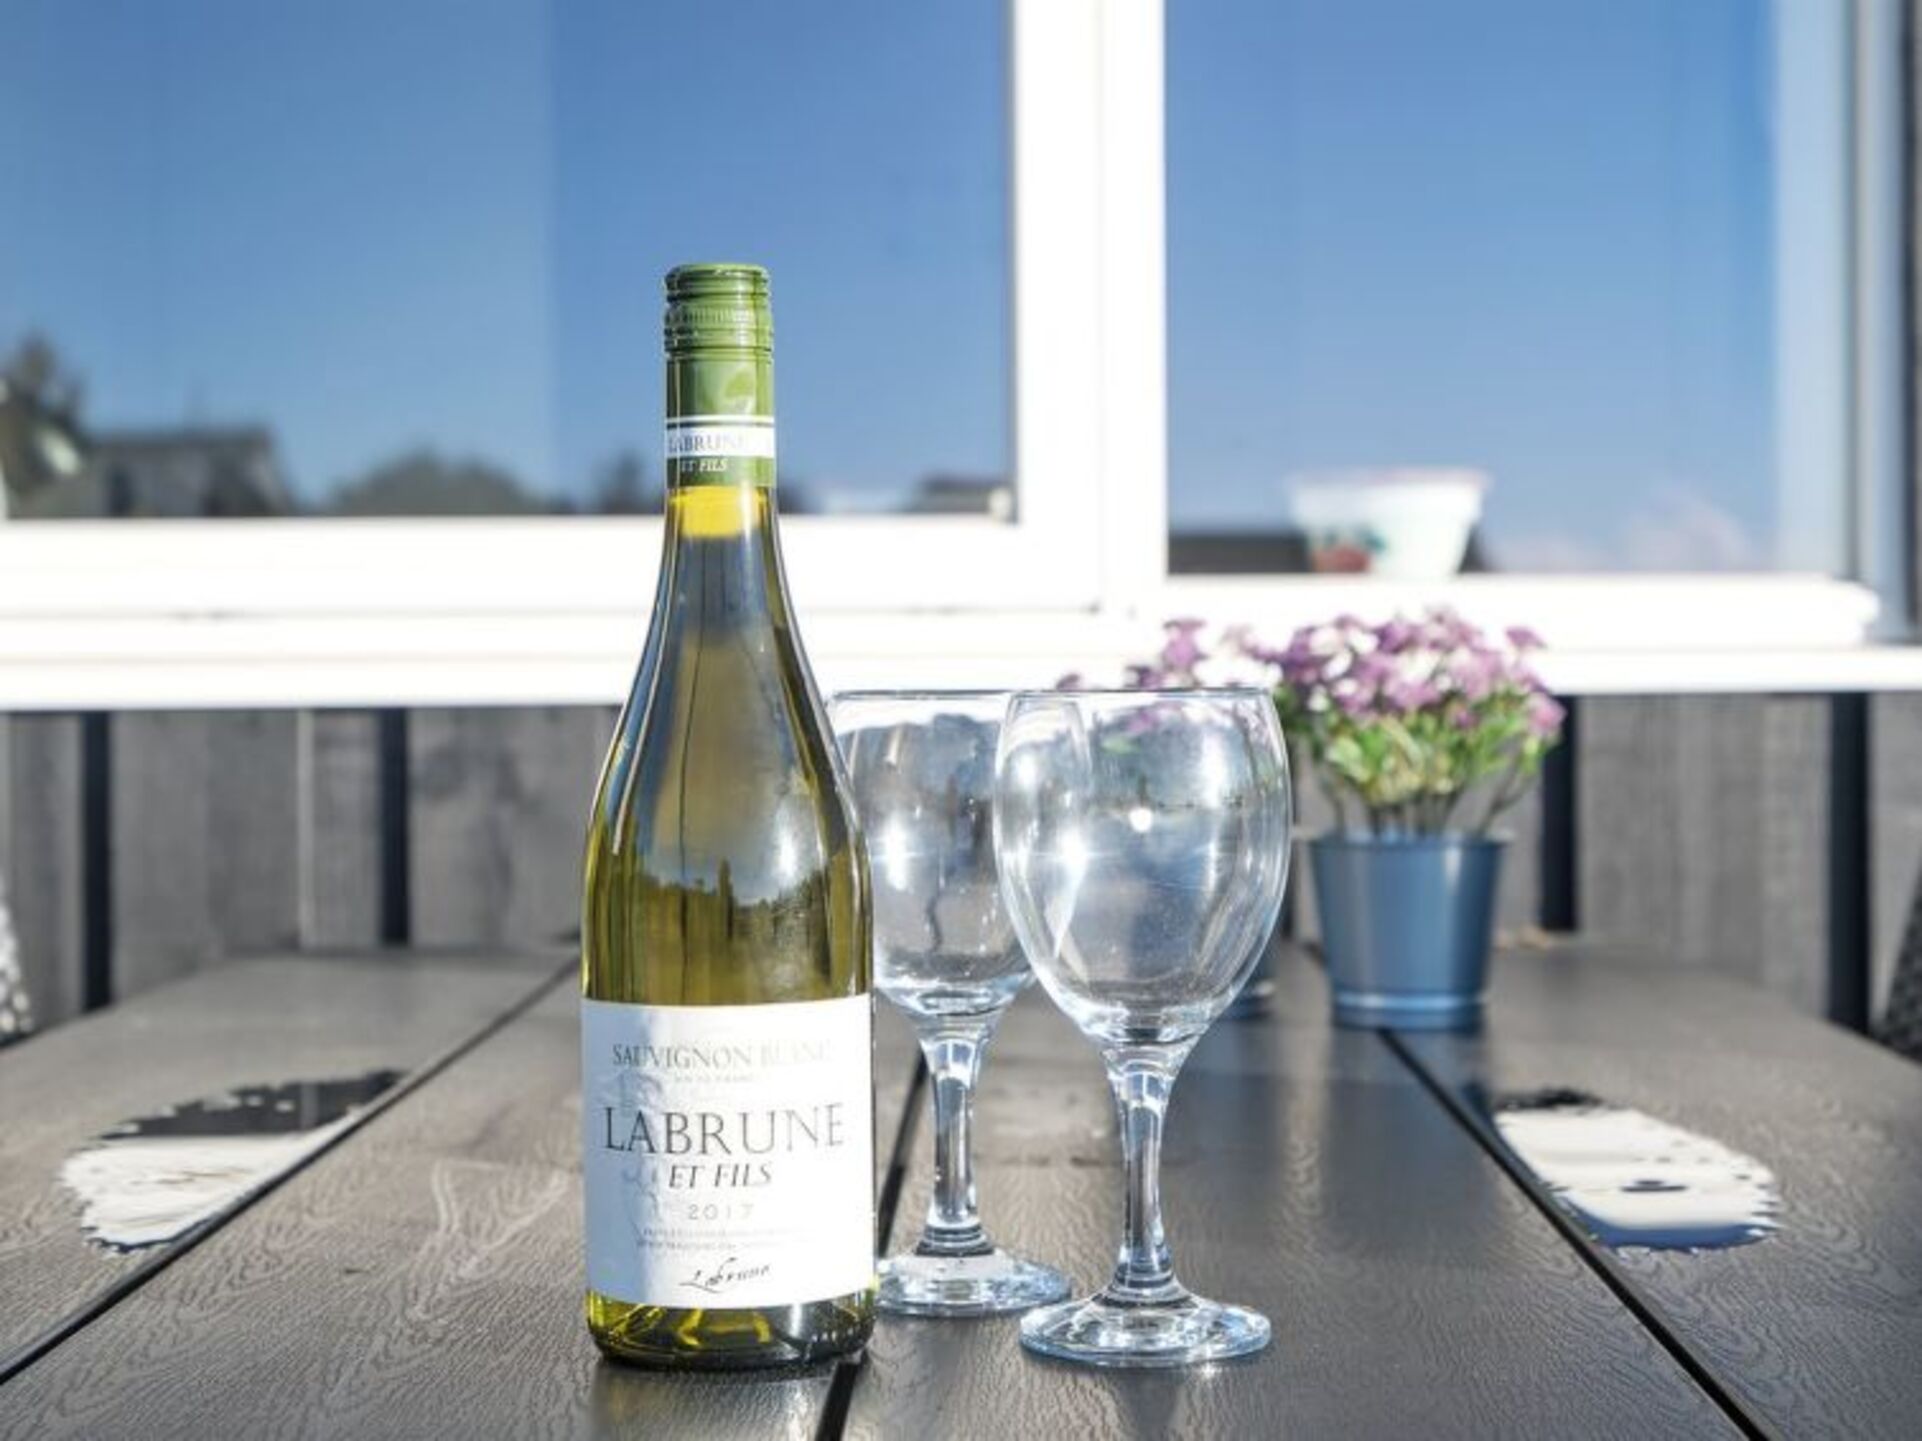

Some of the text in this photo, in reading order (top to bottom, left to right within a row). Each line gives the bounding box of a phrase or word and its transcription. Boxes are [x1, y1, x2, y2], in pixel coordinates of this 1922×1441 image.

[668, 434, 750, 454] LABRUN
[699, 458, 728, 473] FILS
[612, 1044, 752, 1070] SAUVIGNON
[604, 1102, 844, 1155] LABRUNE
[669, 1161, 772, 1189] ET FILS
[687, 1203, 754, 1221] 2017
